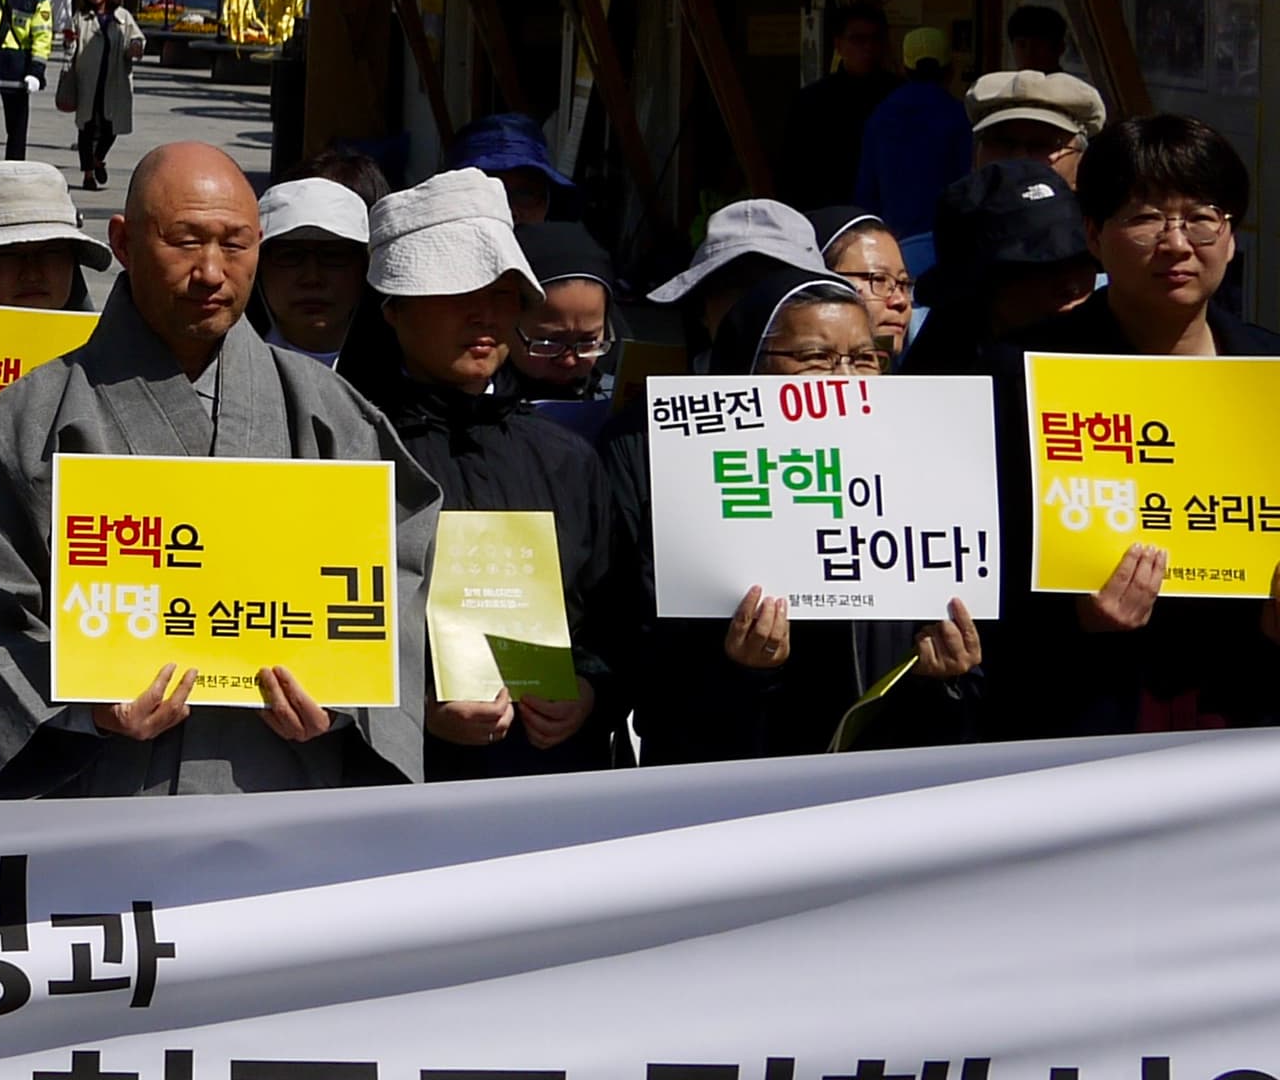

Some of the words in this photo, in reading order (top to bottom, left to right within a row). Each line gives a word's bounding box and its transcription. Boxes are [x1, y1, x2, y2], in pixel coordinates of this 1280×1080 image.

[653, 387, 765, 436] 핵발전
[778, 380, 872, 422] OUT!
[1042, 412, 1175, 464] 탈핵은
[713, 448, 883, 519] 탈핵이
[1045, 477, 1172, 532] 생명을
[66, 514, 204, 568] 탈핵은
[816, 526, 989, 583] 답이다!
[63, 581, 197, 638] 생명을
[208, 600, 314, 639] 살리는
[320, 565, 386, 641] 길
